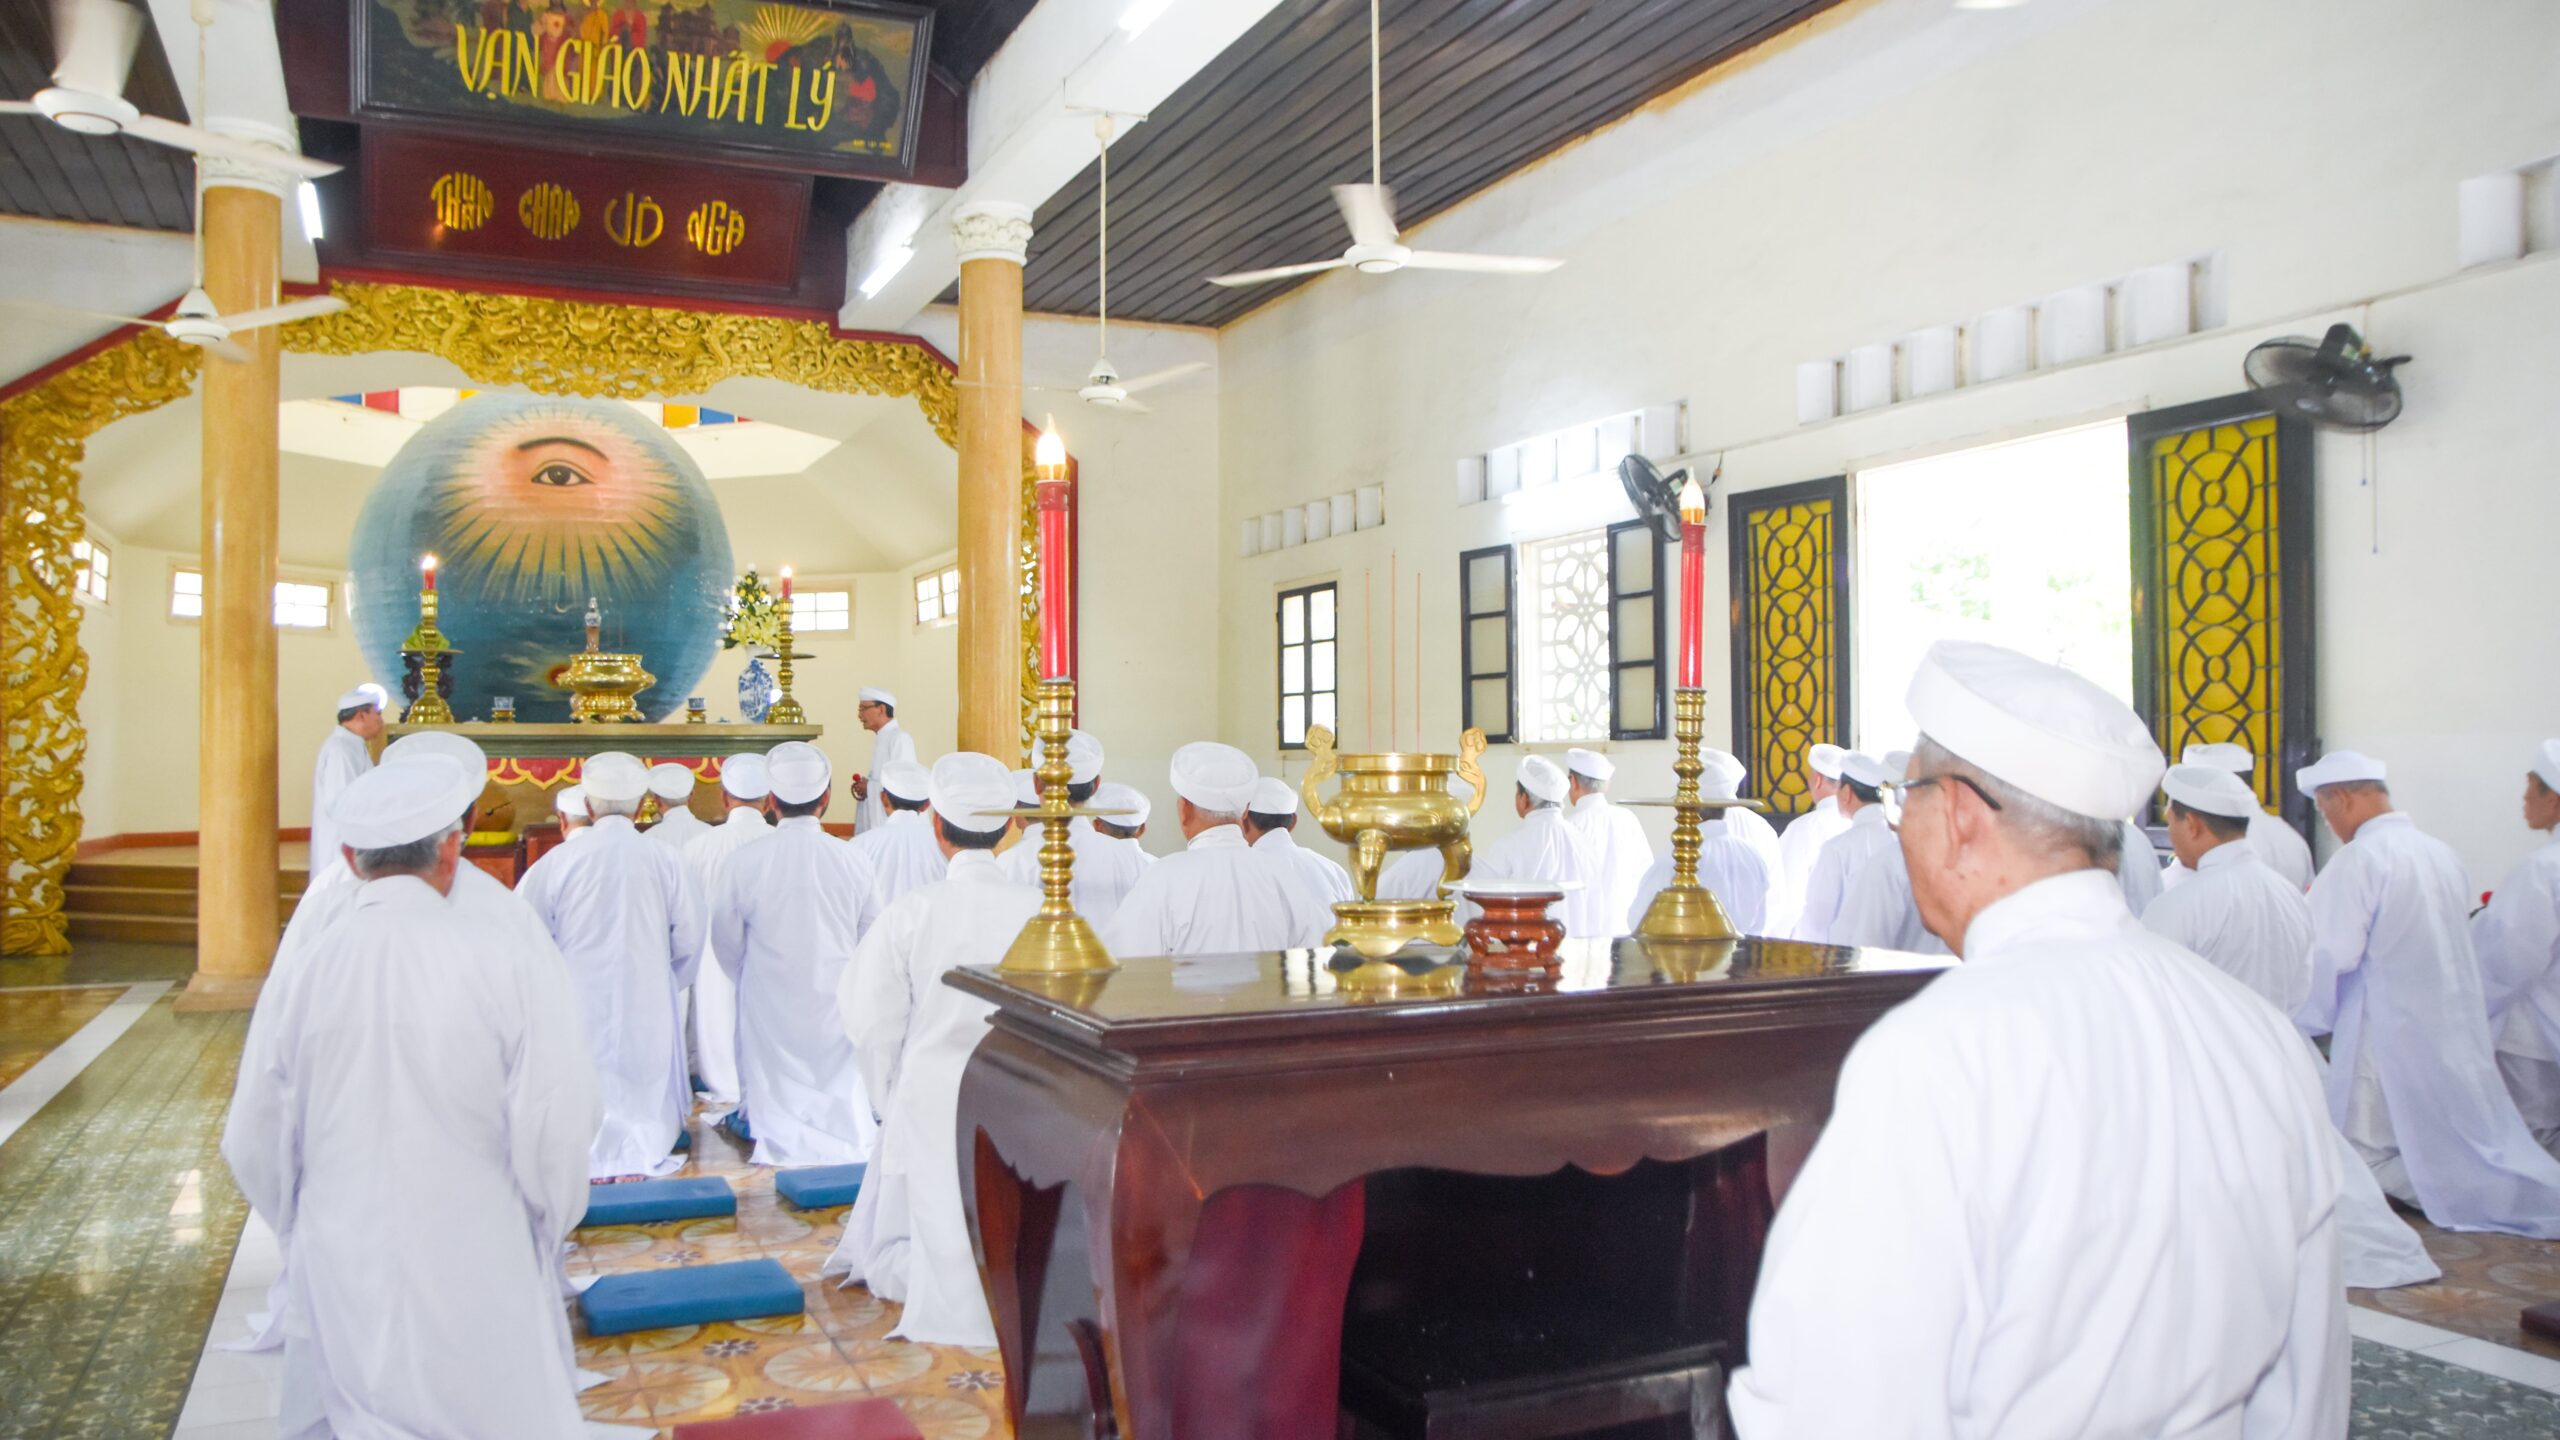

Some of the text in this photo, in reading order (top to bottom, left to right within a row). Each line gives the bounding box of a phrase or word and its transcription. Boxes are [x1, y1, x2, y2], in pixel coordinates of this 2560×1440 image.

[456, 23, 836, 131] VẠN GIÁO NHẤT LÝ
